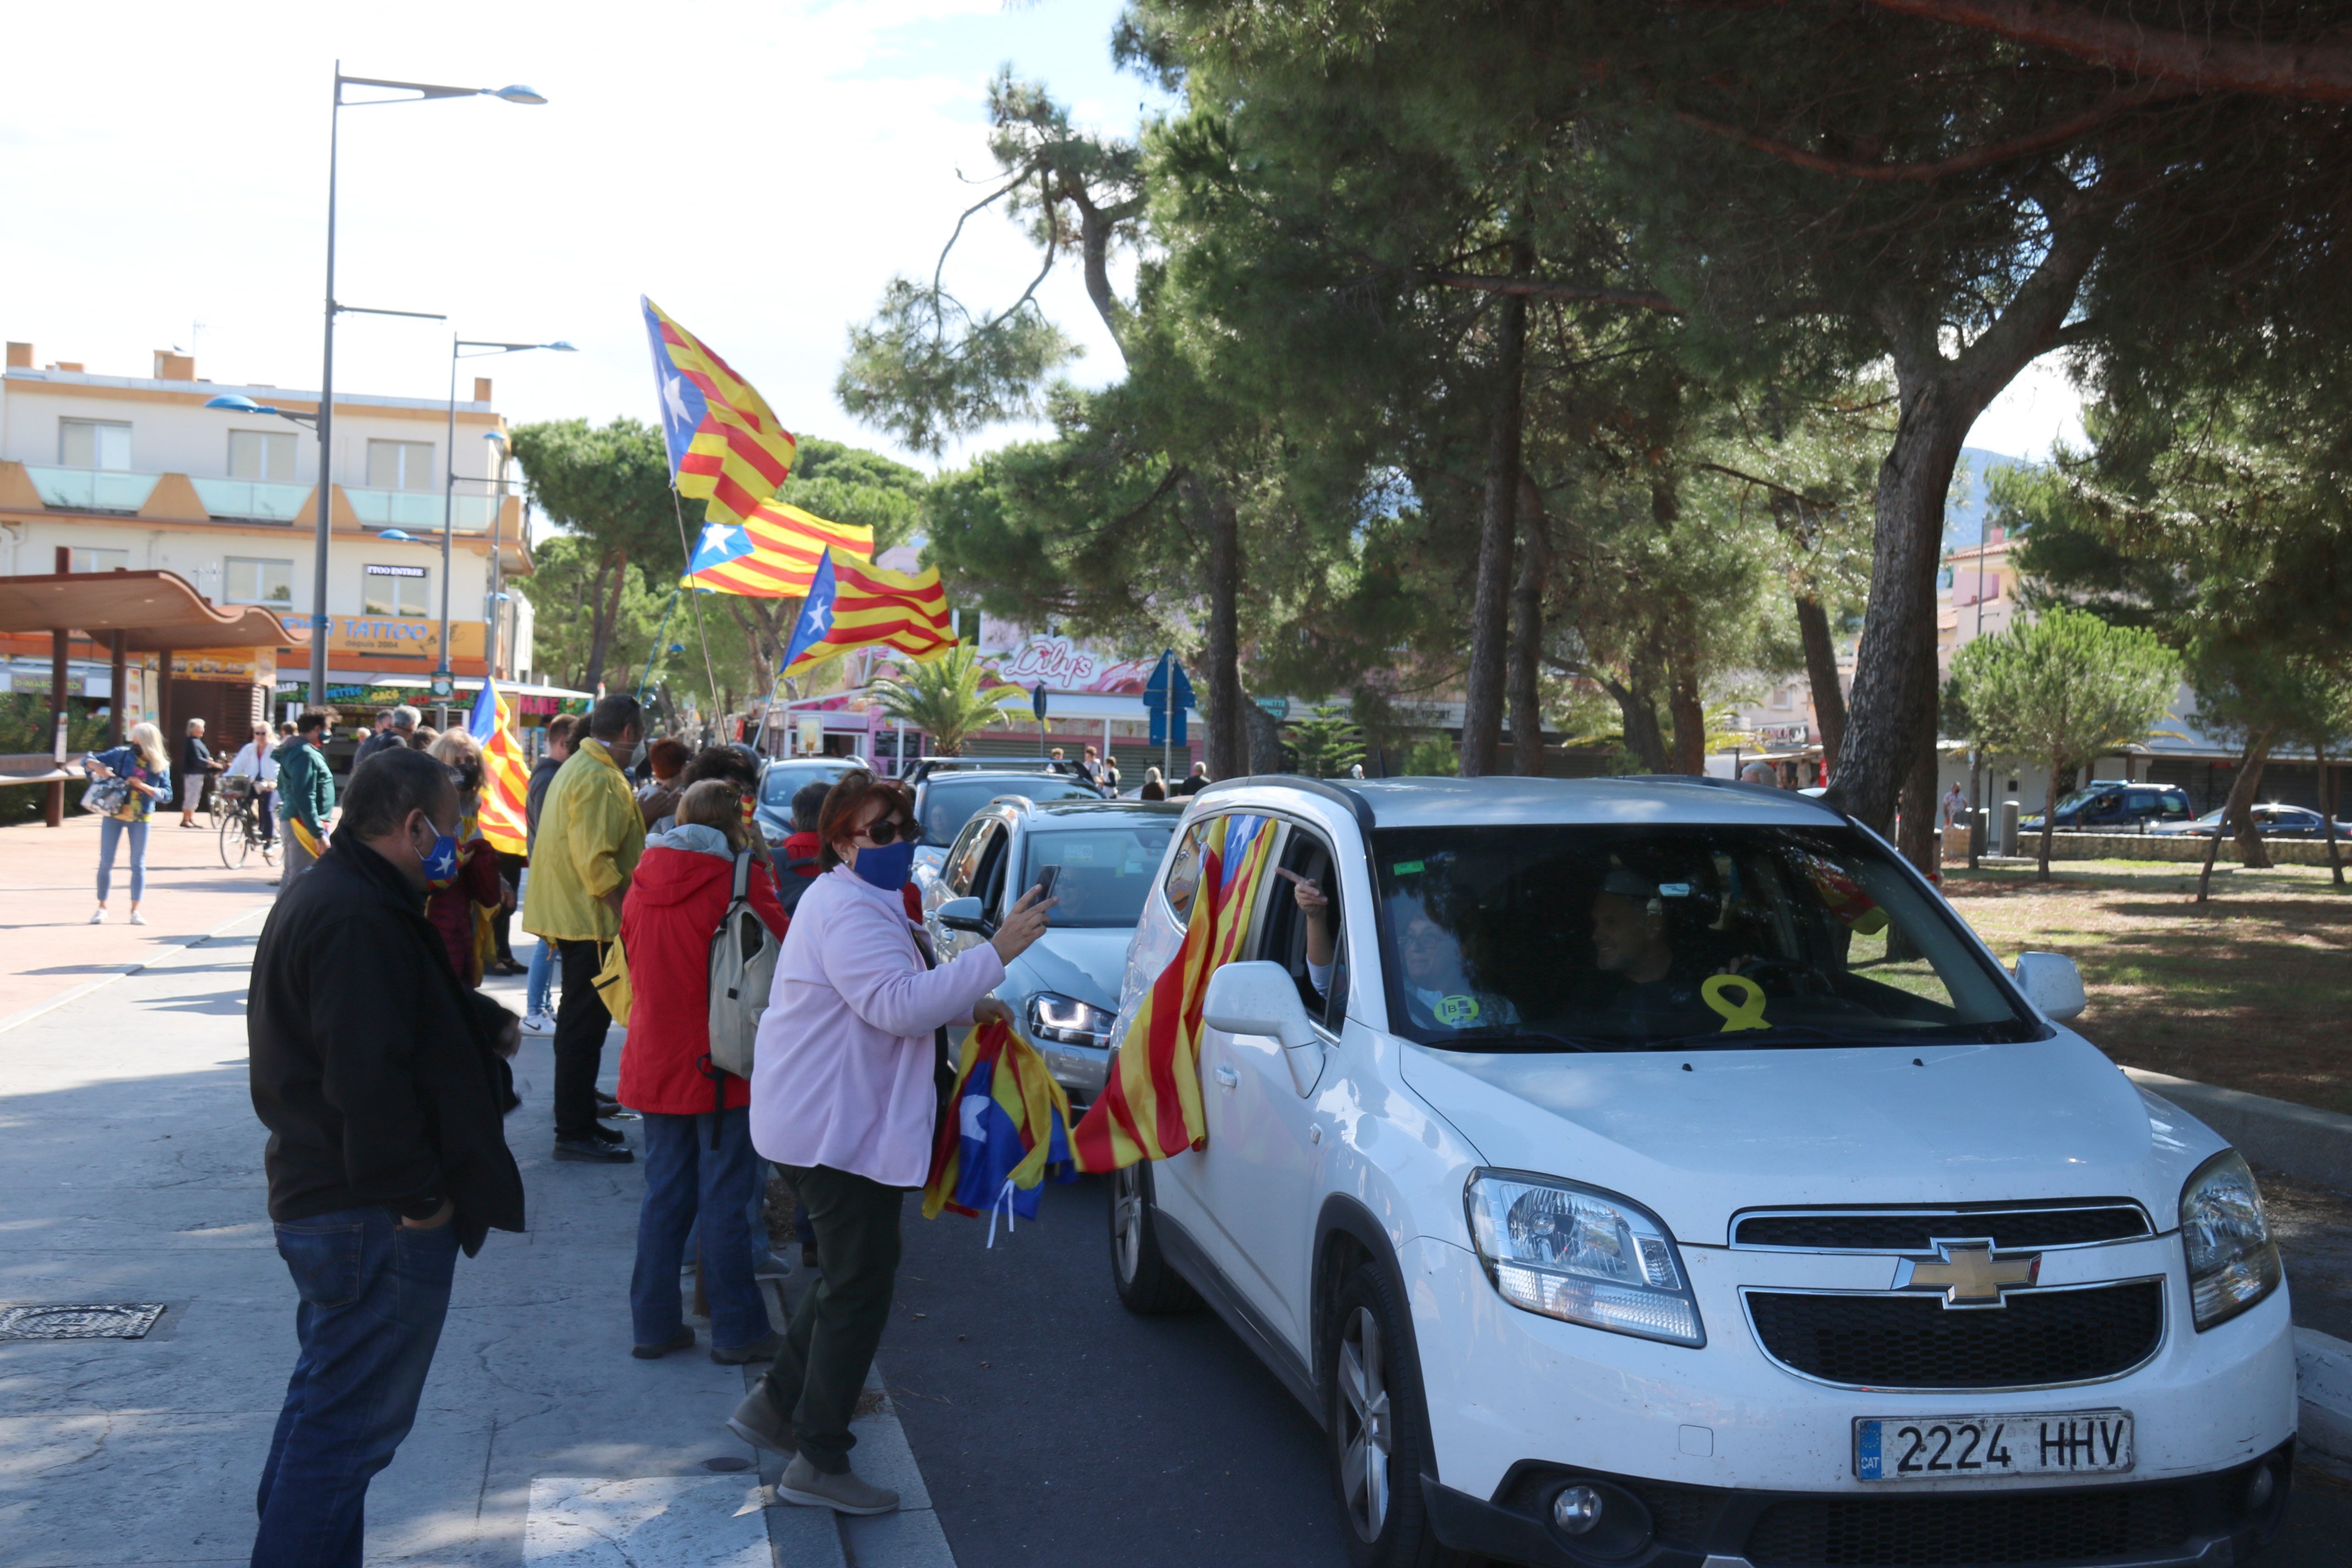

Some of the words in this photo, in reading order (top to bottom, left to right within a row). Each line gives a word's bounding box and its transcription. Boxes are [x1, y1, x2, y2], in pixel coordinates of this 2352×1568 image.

[344, 619, 428, 640] TATTOO
[345, 639, 374, 649] depuis
[378, 640, 399, 649] 2004
[1004, 640, 1093, 688] Lily's
[1447, 1004, 1457, 1013] B
[1897, 1423, 2012, 1473] 2224
[2039, 1419, 2125, 1467] HHV
[1860, 1456, 1880, 1471] CAT
